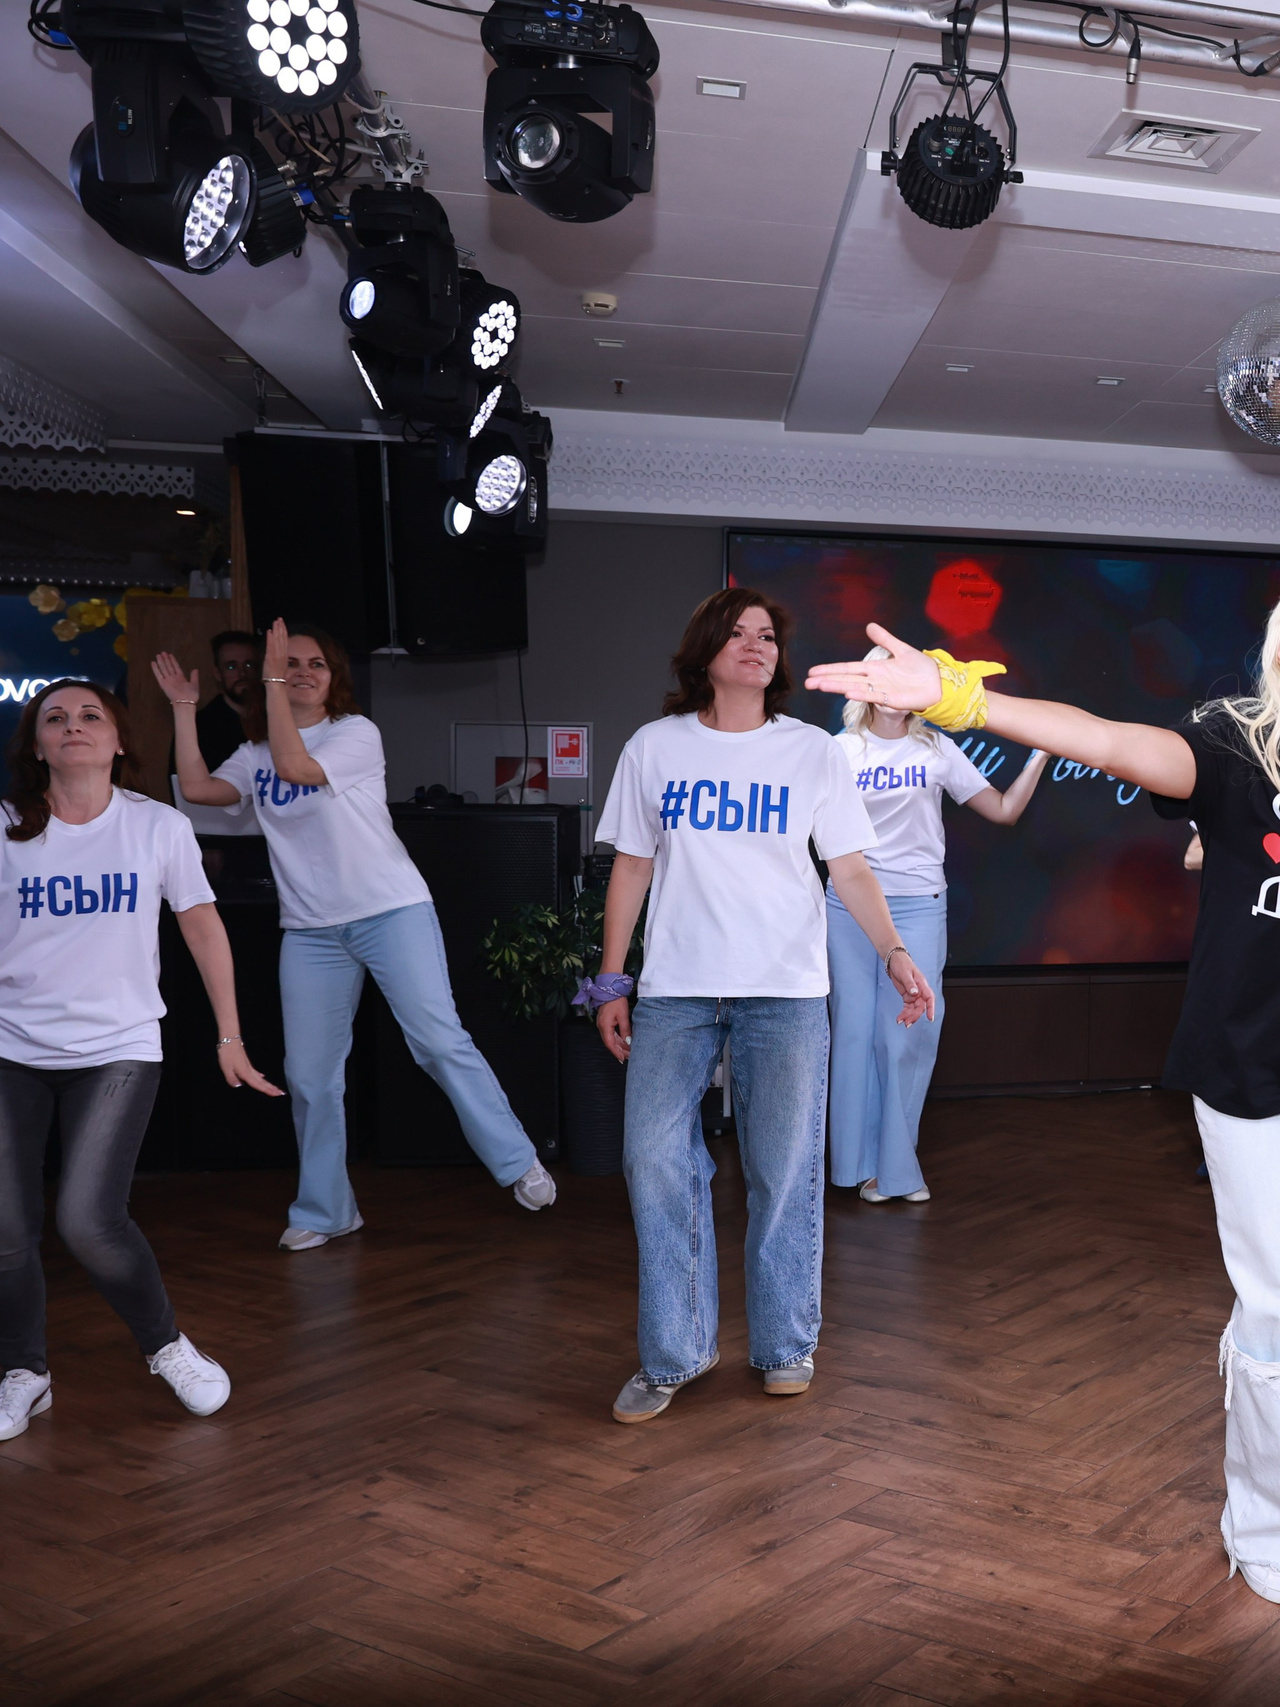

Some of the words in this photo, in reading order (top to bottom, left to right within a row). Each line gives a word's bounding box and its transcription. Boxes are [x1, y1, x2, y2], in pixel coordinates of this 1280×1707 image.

[255, 768, 319, 807] #С
[856, 765, 927, 791] #СЫН
[659, 779, 790, 834] #СЫН
[18, 872, 138, 918] #СЫН
